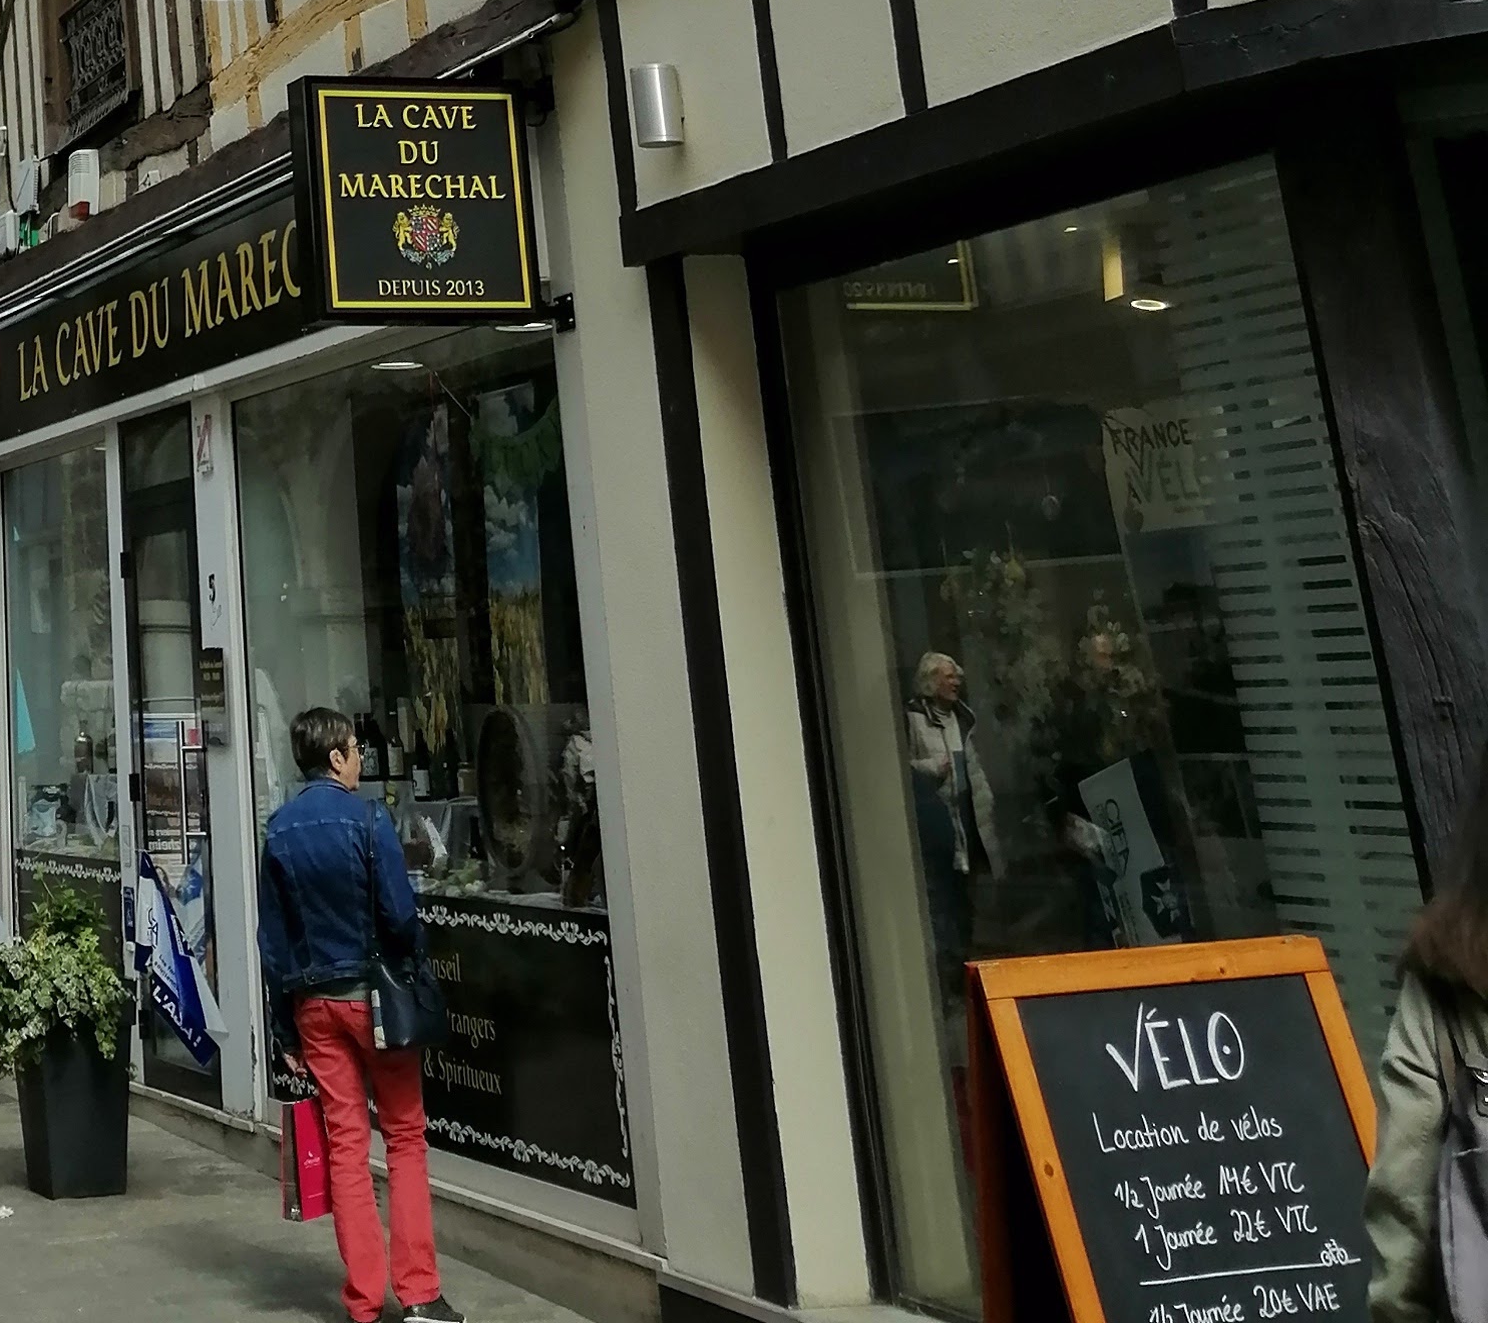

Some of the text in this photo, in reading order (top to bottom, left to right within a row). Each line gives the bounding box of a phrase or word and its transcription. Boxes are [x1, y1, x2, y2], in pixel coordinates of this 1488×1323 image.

[355, 103, 477, 130] LA CAVE
[398, 140, 439, 165] DU
[338, 172, 507, 200] MARECHAL
[378, 278, 485, 297] DEPUIS 2013
[17, 219, 301, 402] LA CAVE DU MAREC
[446, 1008, 497, 1049] rangers
[1105, 1001, 1246, 1092] VÉLO
[423, 1046, 503, 1096] & Spiritueux
[1092, 1105, 1284, 1154] Location de vélos
[1141, 1173, 1206, 1220] Journée
[1219, 1165, 1258, 1196] 14€
[1262, 1161, 1305, 1195] VTC
[1134, 1204, 1318, 1271] 1 Journée 22€ VTC
[1297, 1282, 1341, 1314] VAE
